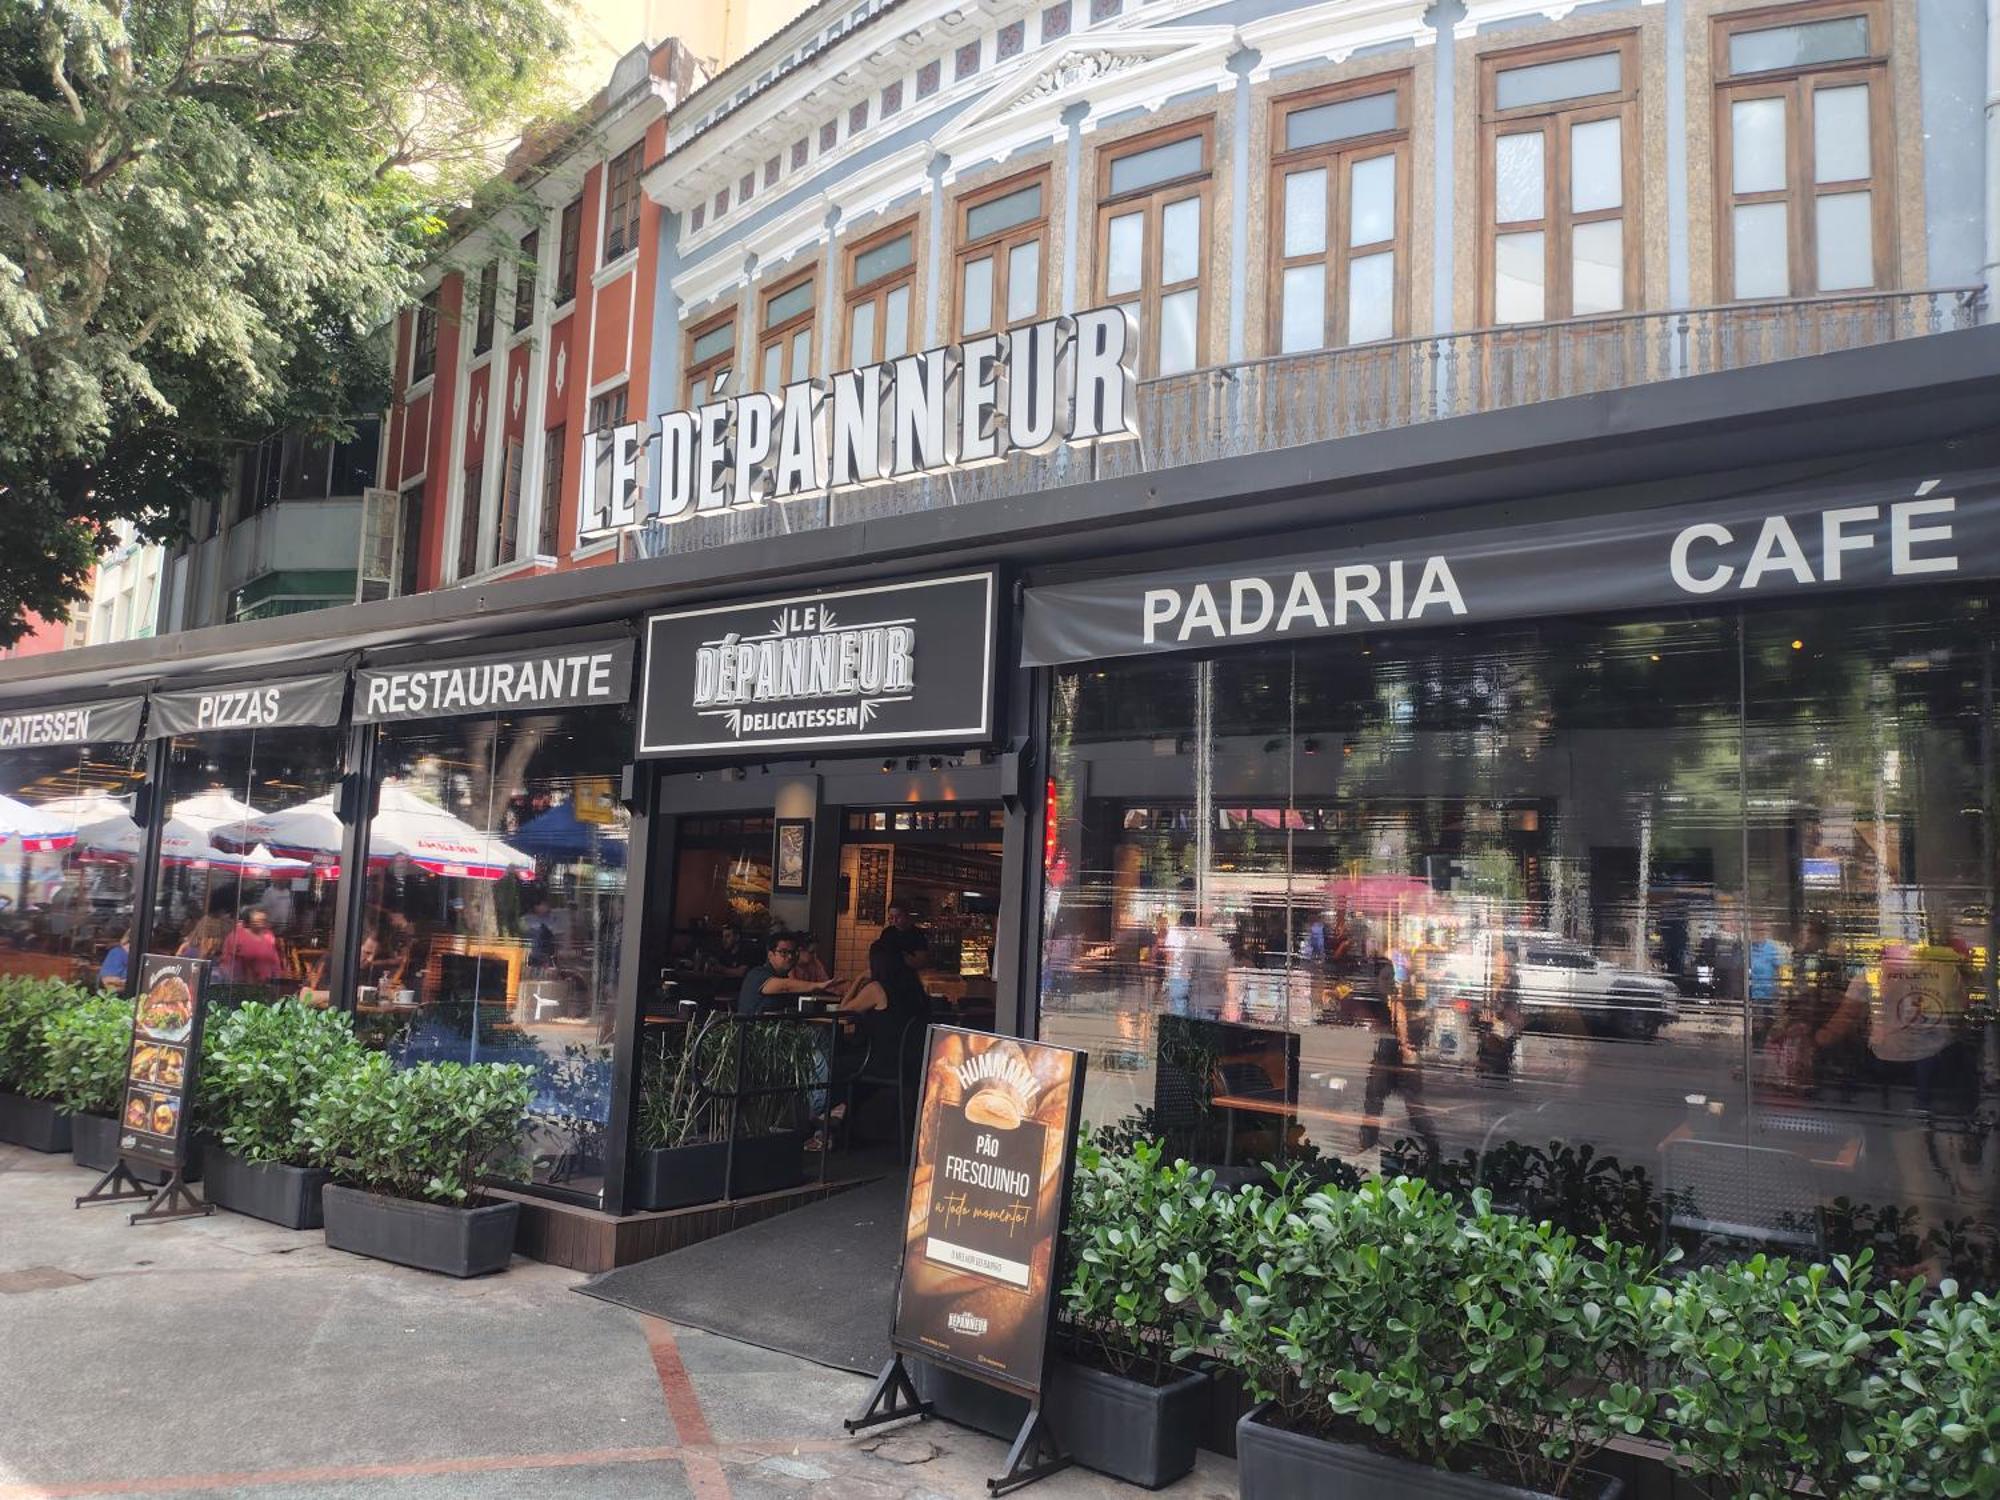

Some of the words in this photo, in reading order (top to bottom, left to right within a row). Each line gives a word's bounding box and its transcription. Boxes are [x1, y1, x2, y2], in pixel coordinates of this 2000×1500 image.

[579, 421, 645, 535] LE
[656, 305, 1134, 520] DÉPANNEUR
[1669, 479, 1959, 594] CAFÉ
[790, 607, 817, 632] LE
[1143, 555, 1468, 644] PADARIA
[367, 653, 613, 714] RESTAURANTE
[693, 626, 915, 707] DÉPANNEUR
[0, 710, 91, 745] CATESSEN
[197, 688, 280, 729] PIZZAS
[742, 707, 859, 732] DELICATESSEN
[976, 1133, 1000, 1158] PÃO
[945, 1154, 1030, 1198] FRESQUINHO
